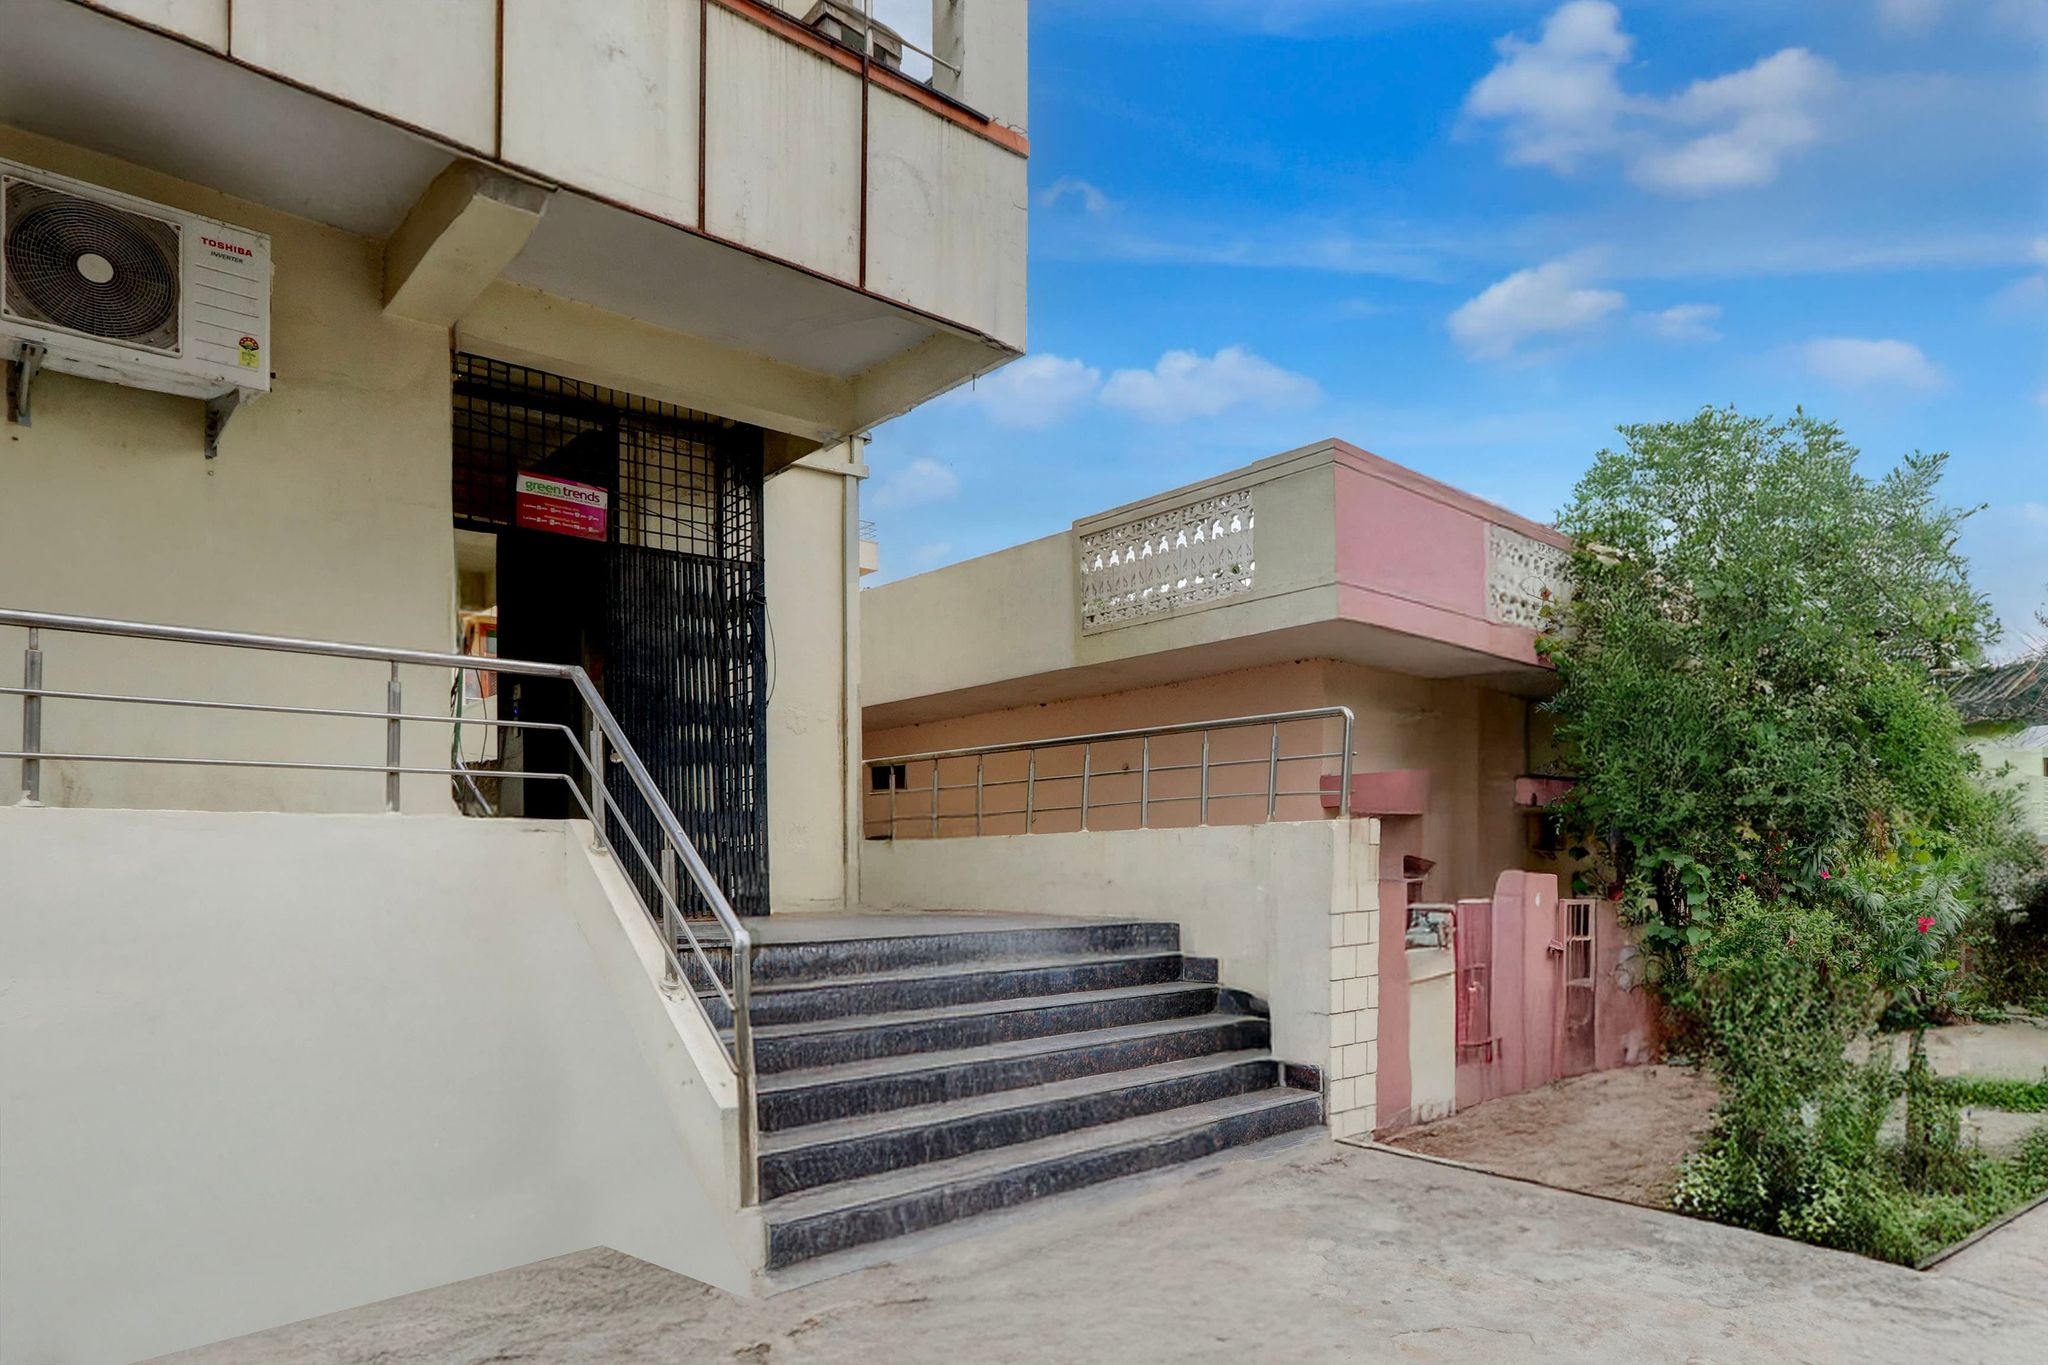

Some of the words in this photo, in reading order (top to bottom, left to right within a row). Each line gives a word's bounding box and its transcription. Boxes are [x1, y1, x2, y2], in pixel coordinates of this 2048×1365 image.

[201, 236, 253, 257] TOSHIBA
[210, 251, 244, 264] INVERTER
[525, 481, 561, 495] green
[563, 487, 600, 503] trends
